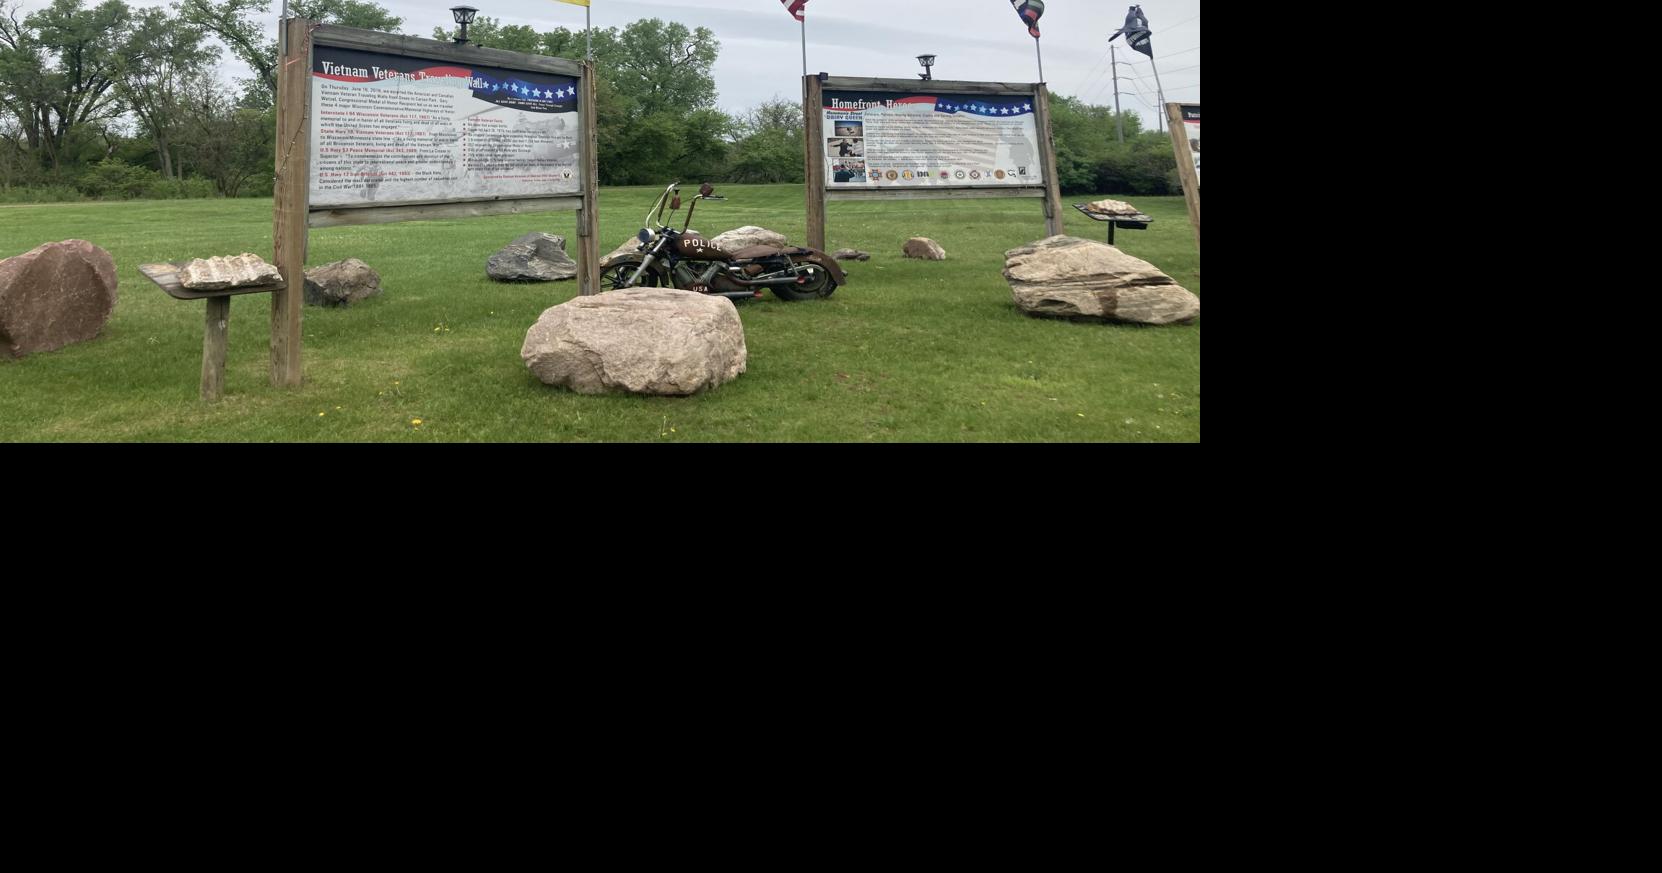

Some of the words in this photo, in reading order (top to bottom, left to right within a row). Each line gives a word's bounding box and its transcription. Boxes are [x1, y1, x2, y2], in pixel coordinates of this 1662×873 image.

[322, 62, 368, 78] Vietnam
[372, 66, 416, 81] Veterans
[465, 76, 482, 88] Wall
[831, 98, 880, 109] Homefront
[886, 100, 913, 109] Hero
[684, 239, 721, 251] POLICE
